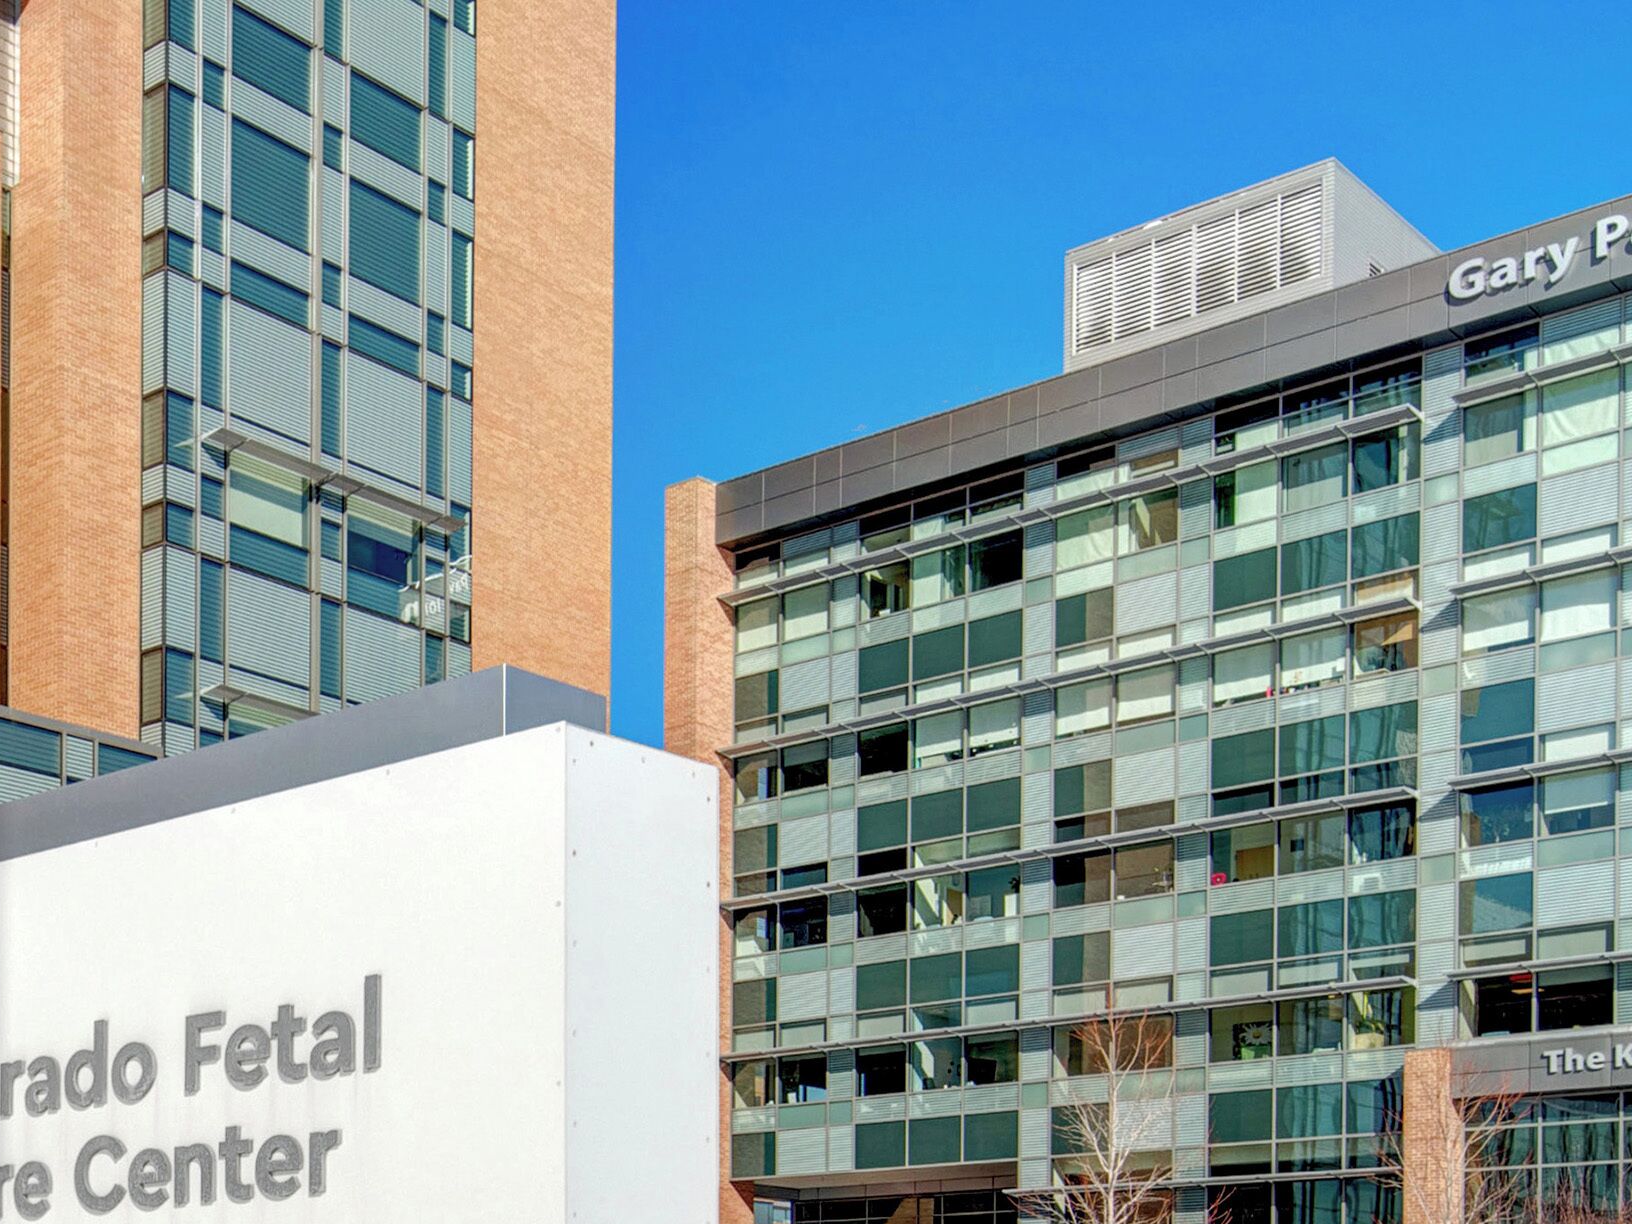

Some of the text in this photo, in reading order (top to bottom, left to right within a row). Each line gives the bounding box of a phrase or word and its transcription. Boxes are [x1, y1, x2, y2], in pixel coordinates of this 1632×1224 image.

[1448, 213, 1632, 300] Gary P
[183, 973, 383, 1097] Fetal
[1543, 1047, 1606, 1074] The
[74, 1126, 342, 1216] Center
